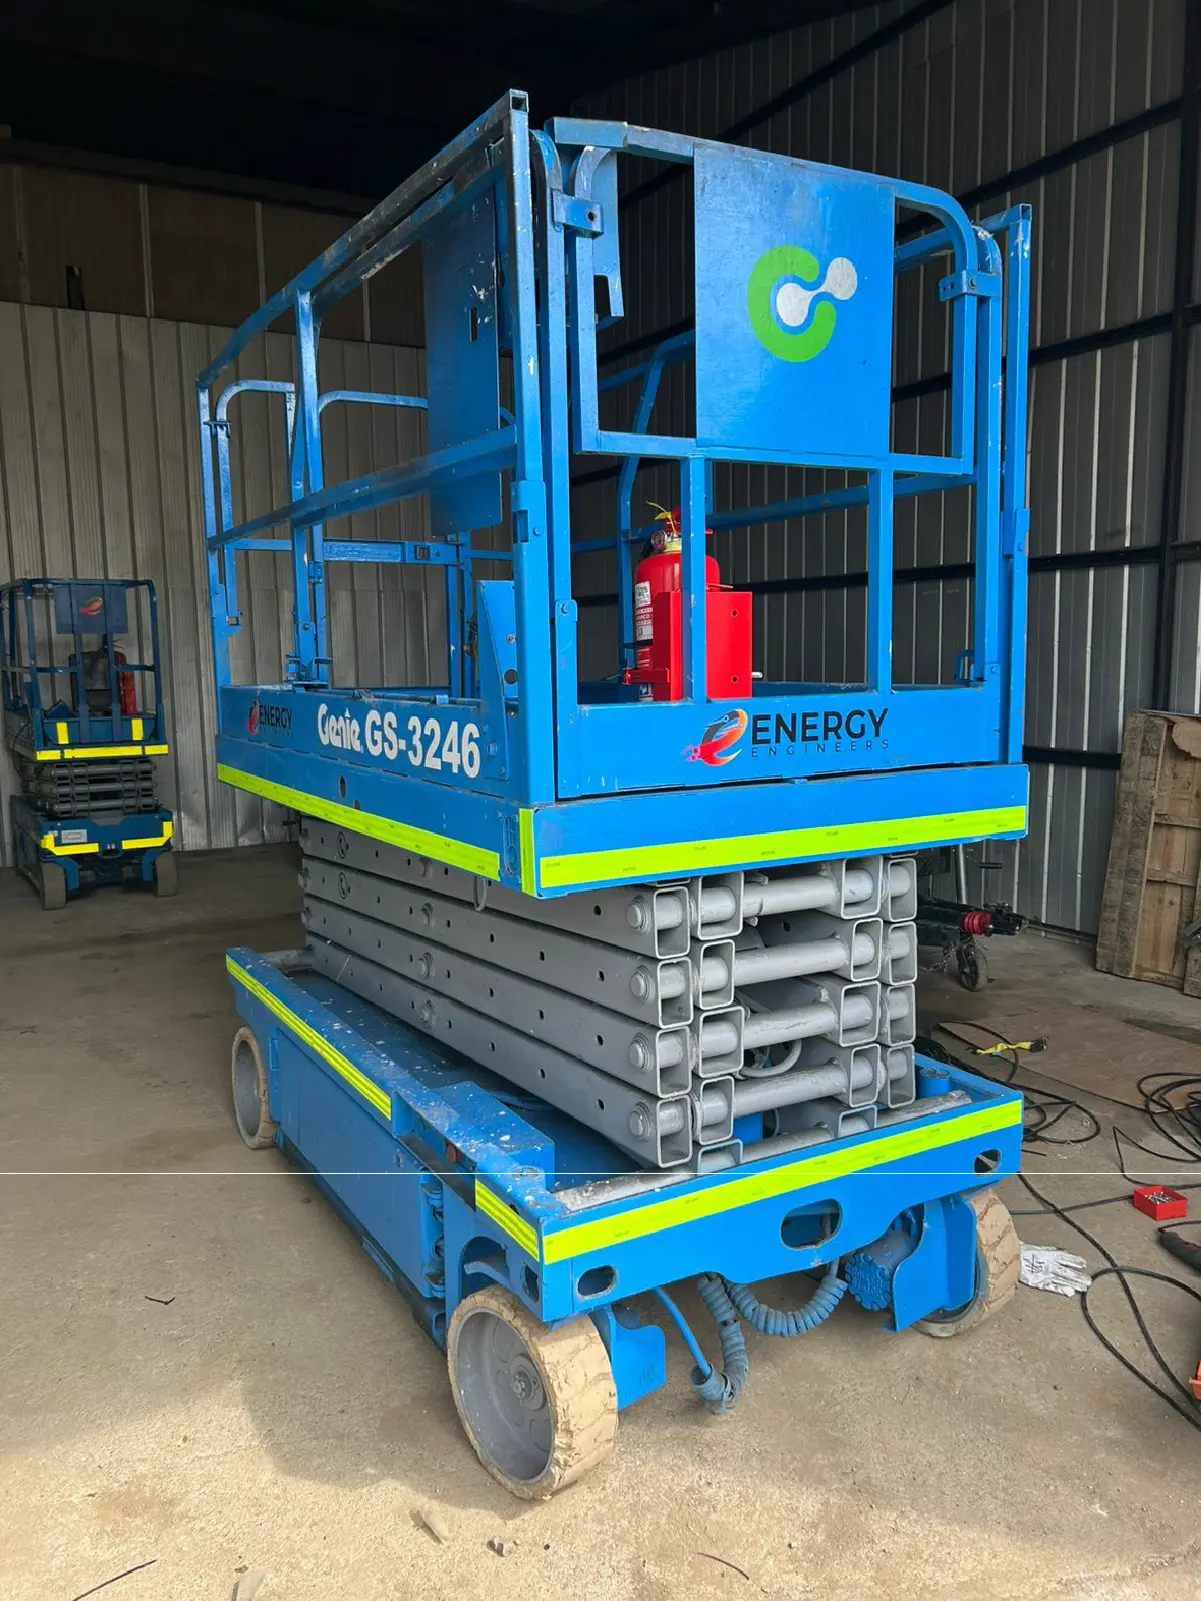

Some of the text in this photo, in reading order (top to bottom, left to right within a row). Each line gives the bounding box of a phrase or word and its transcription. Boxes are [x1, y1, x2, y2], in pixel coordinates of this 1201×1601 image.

[259, 704, 293, 730] ENERGY
[752, 708, 889, 745] ENERGY
[317, 703, 480, 778] Genie GS-3246
[751, 740, 889, 758] ENGINEERS
